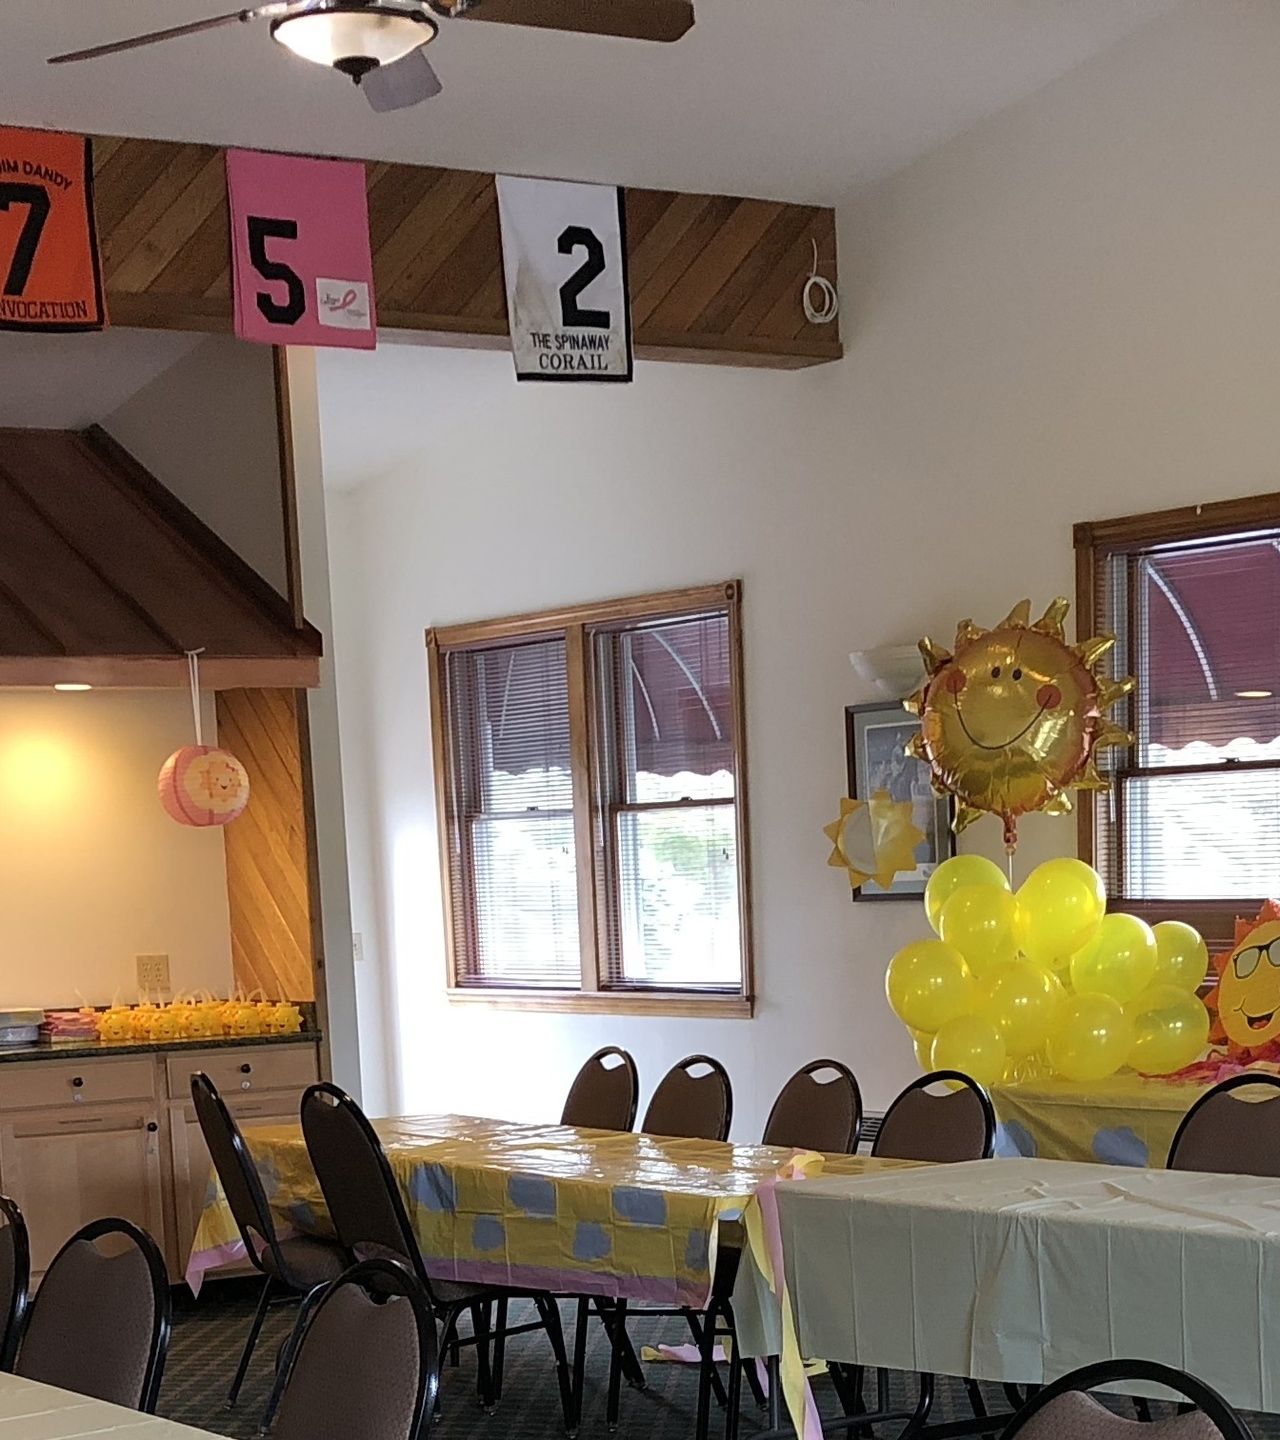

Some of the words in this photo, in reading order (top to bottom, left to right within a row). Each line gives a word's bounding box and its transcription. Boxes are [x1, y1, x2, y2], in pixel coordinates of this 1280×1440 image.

[23, 160, 72, 190] DANDY
[248, 217, 306, 325] 5
[558, 225, 610, 328] 2
[530, 332, 552, 349] THE
[554, 334, 609, 351] SPINAWAY
[540, 353, 608, 370] CORAIL
